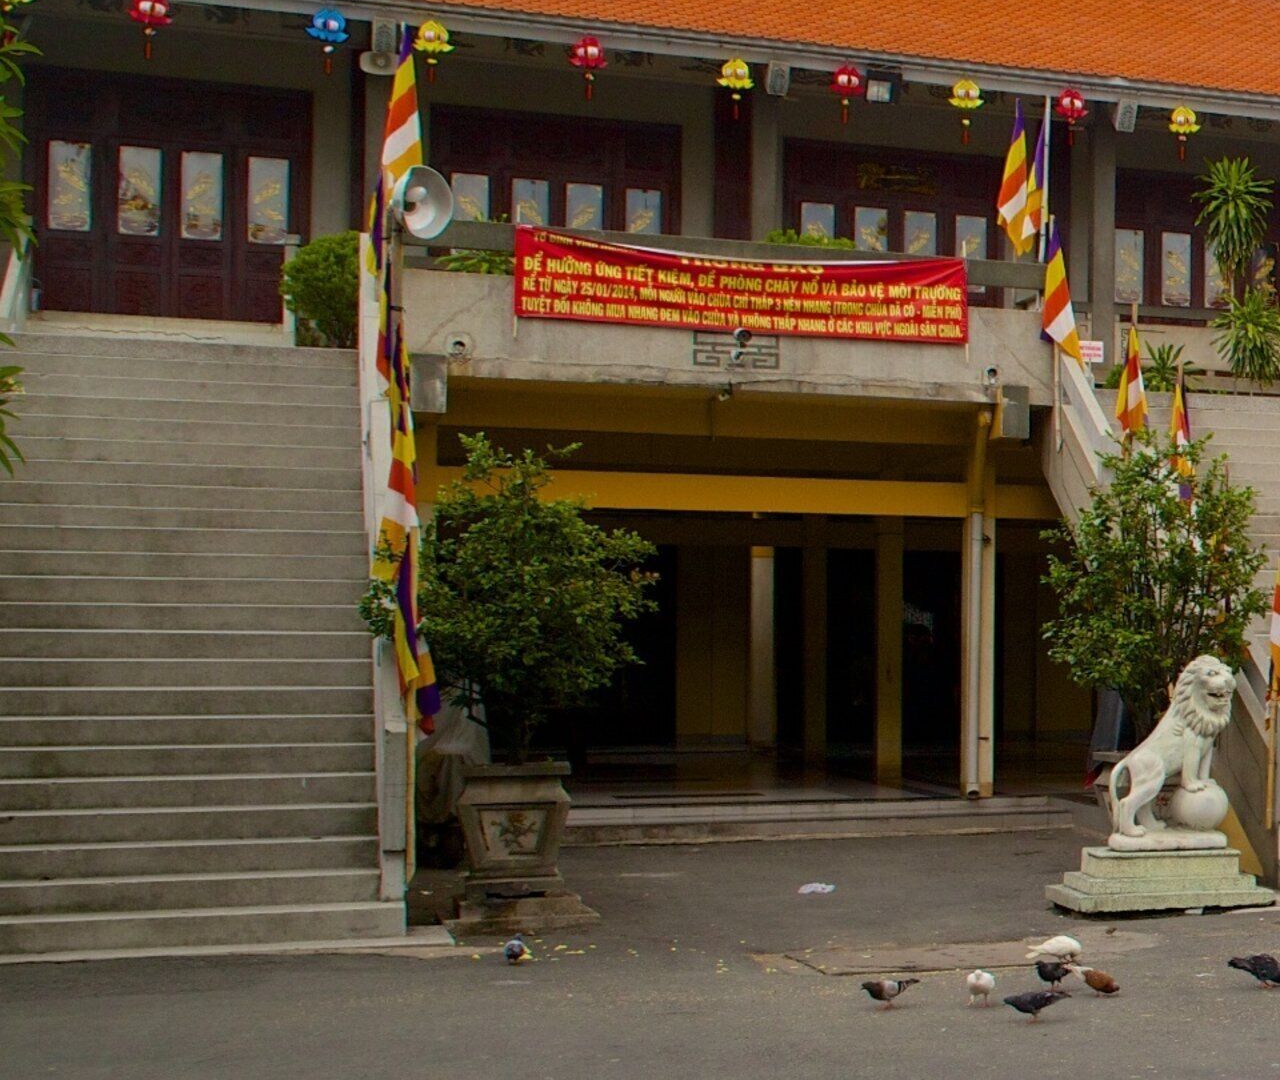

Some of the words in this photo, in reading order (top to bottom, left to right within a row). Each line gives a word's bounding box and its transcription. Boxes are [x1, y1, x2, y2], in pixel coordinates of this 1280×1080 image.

[554, 277, 579, 295] NGÀY
[596, 261, 621, 279] ỨNG
[720, 273, 762, 291] PHÒNG
[765, 277, 799, 294] CHÁY
[801, 275, 820, 294] NỔ
[822, 280, 838, 296] VÀ
[841, 279, 866, 297] BẢO
[869, 282, 885, 300] VỆ
[888, 282, 912, 299] MÔI
[914, 284, 962, 301] TRƯỜNG
[572, 299, 604, 316] KHÔNG
